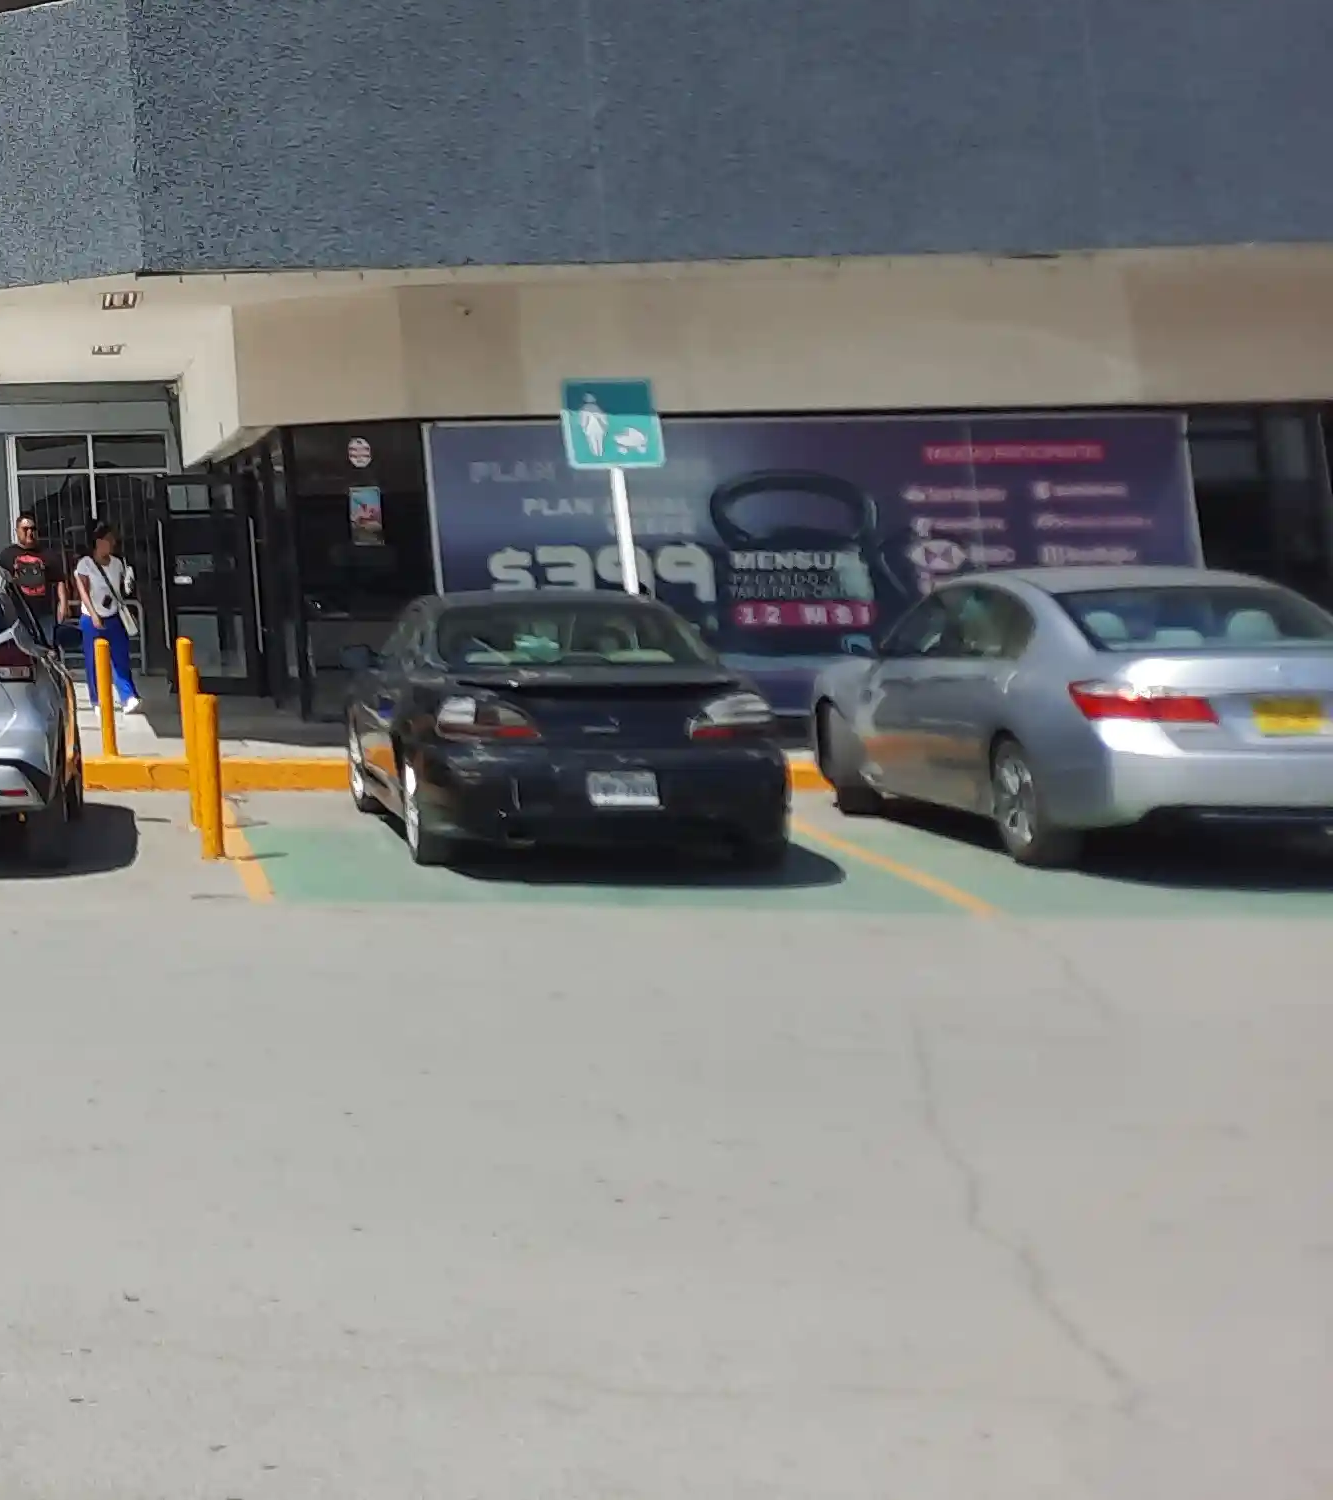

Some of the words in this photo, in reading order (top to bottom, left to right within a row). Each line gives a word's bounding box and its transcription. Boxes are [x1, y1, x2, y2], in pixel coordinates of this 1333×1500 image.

[468, 461, 556, 484] PLAN
[522, 499, 594, 516] PLAN
[730, 551, 838, 570] MENSU
